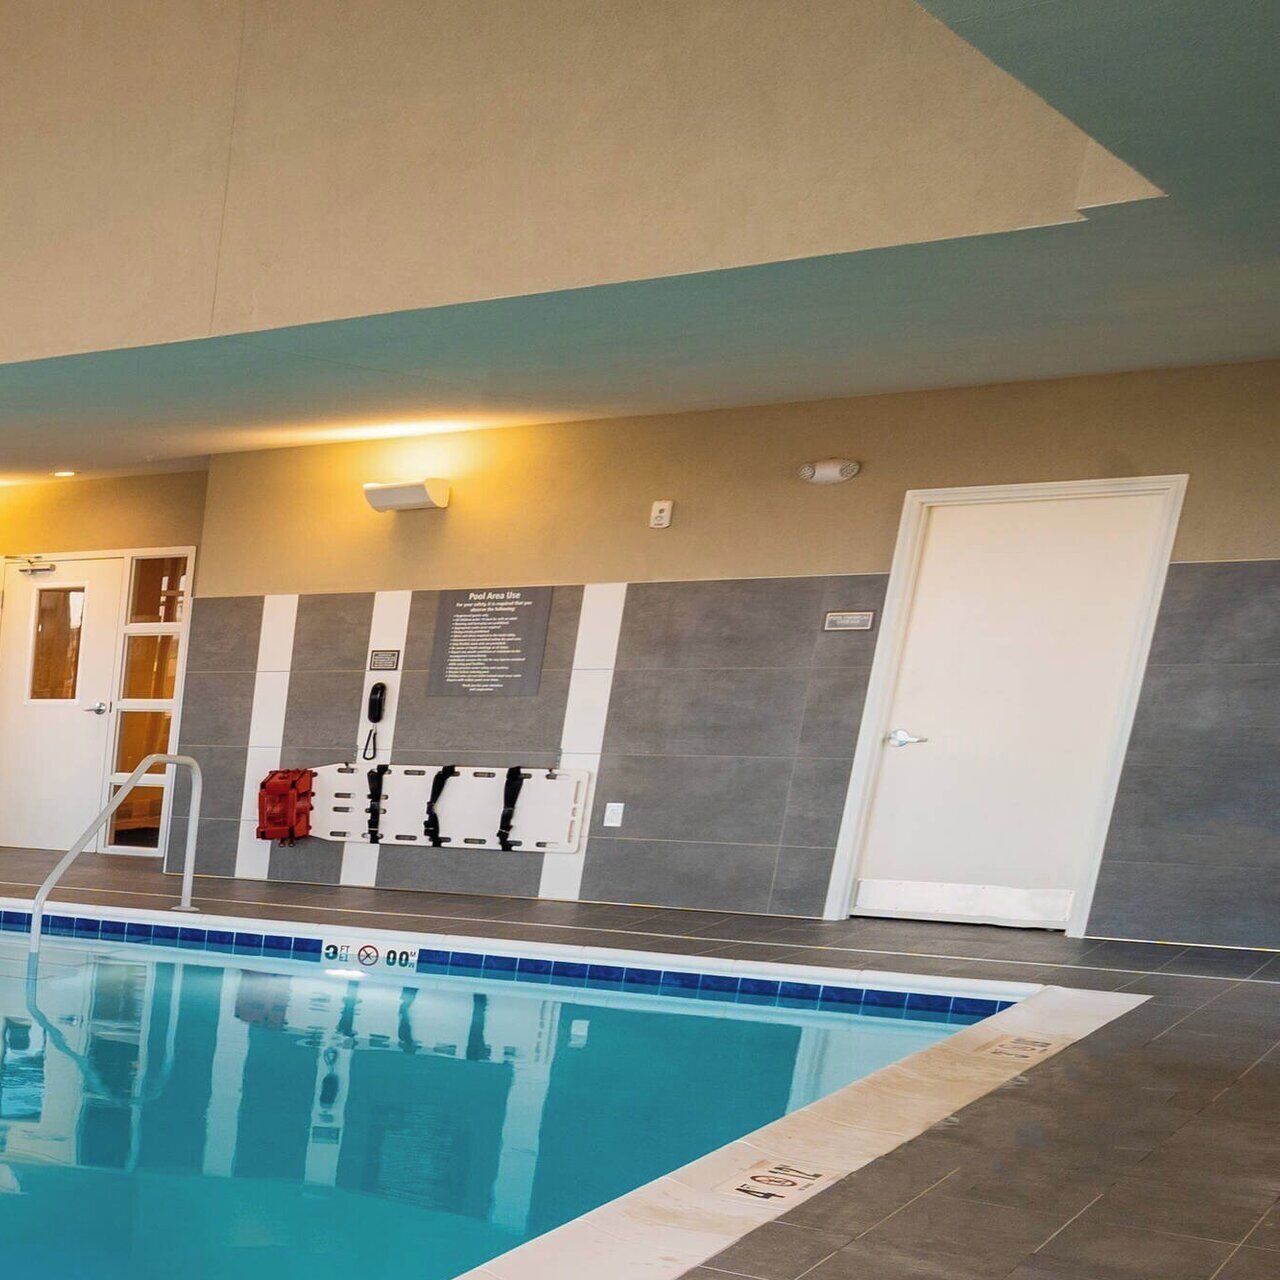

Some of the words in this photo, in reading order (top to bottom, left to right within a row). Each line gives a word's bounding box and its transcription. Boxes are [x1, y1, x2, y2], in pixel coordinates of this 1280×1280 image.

[469, 592, 486, 600] Pool
[486, 591, 505, 600] Area
[506, 591, 521, 599] Use
